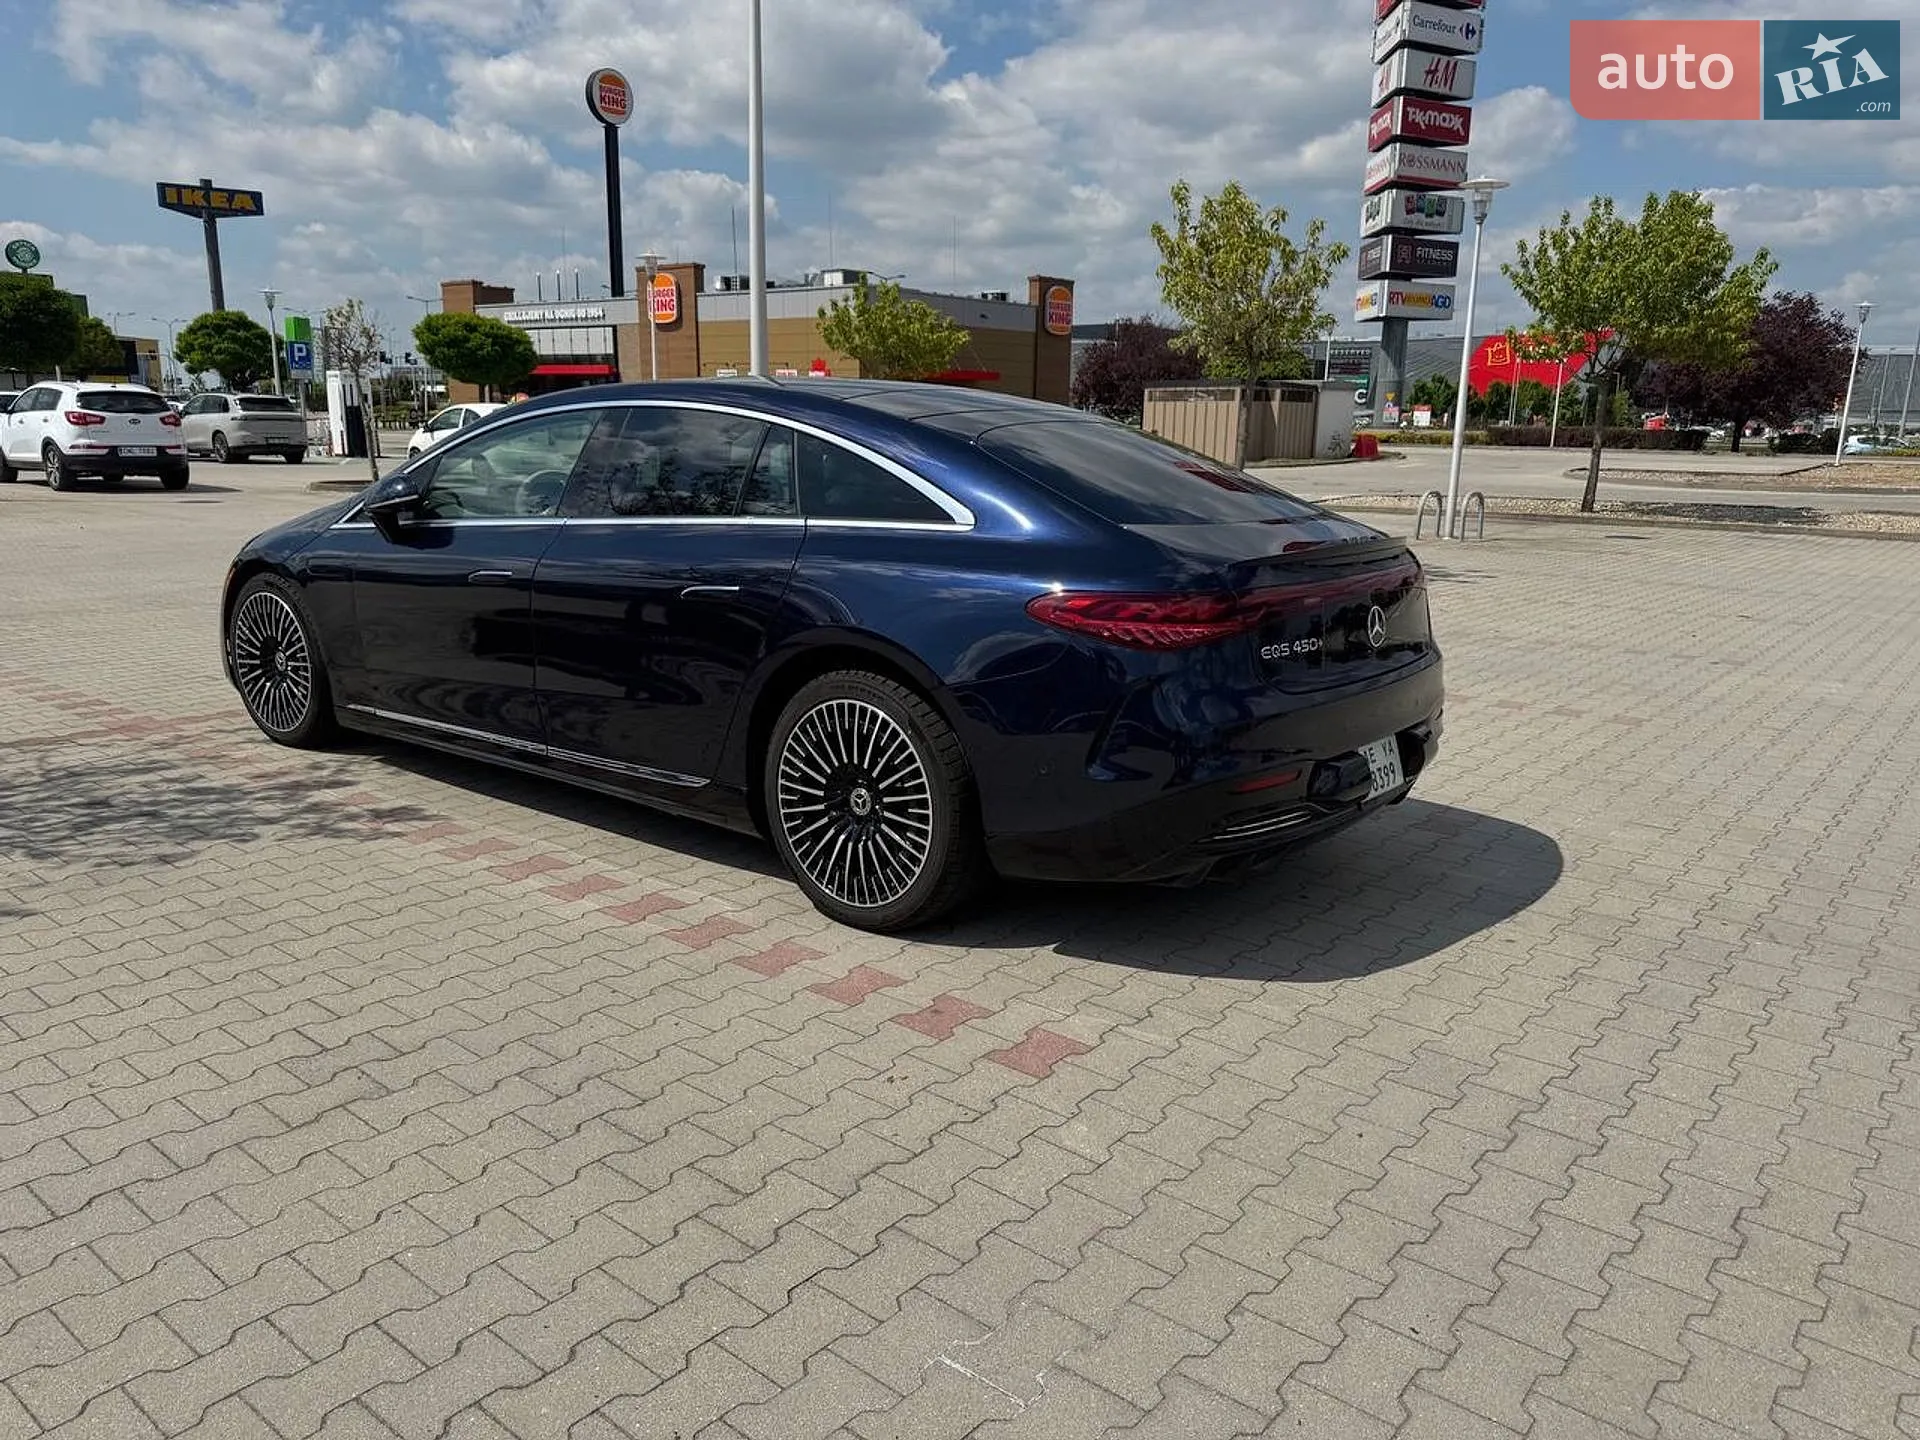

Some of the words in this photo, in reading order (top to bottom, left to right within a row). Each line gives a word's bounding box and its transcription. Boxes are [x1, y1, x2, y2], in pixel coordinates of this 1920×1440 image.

[1413, 14, 1457, 34] Carrefour
[1423, 57, 1458, 92] H&M
[599, 85, 625, 97] BURGER
[600, 94, 627, 109] KING
[1399, 152, 1465, 176] ROSSMANN
[165, 187, 257, 211] IKEA
[1416, 247, 1454, 261] FITNESS
[1048, 311, 1072, 325] KING
[295, 343, 307, 361] P
[1261, 643, 1290, 660] EQS
